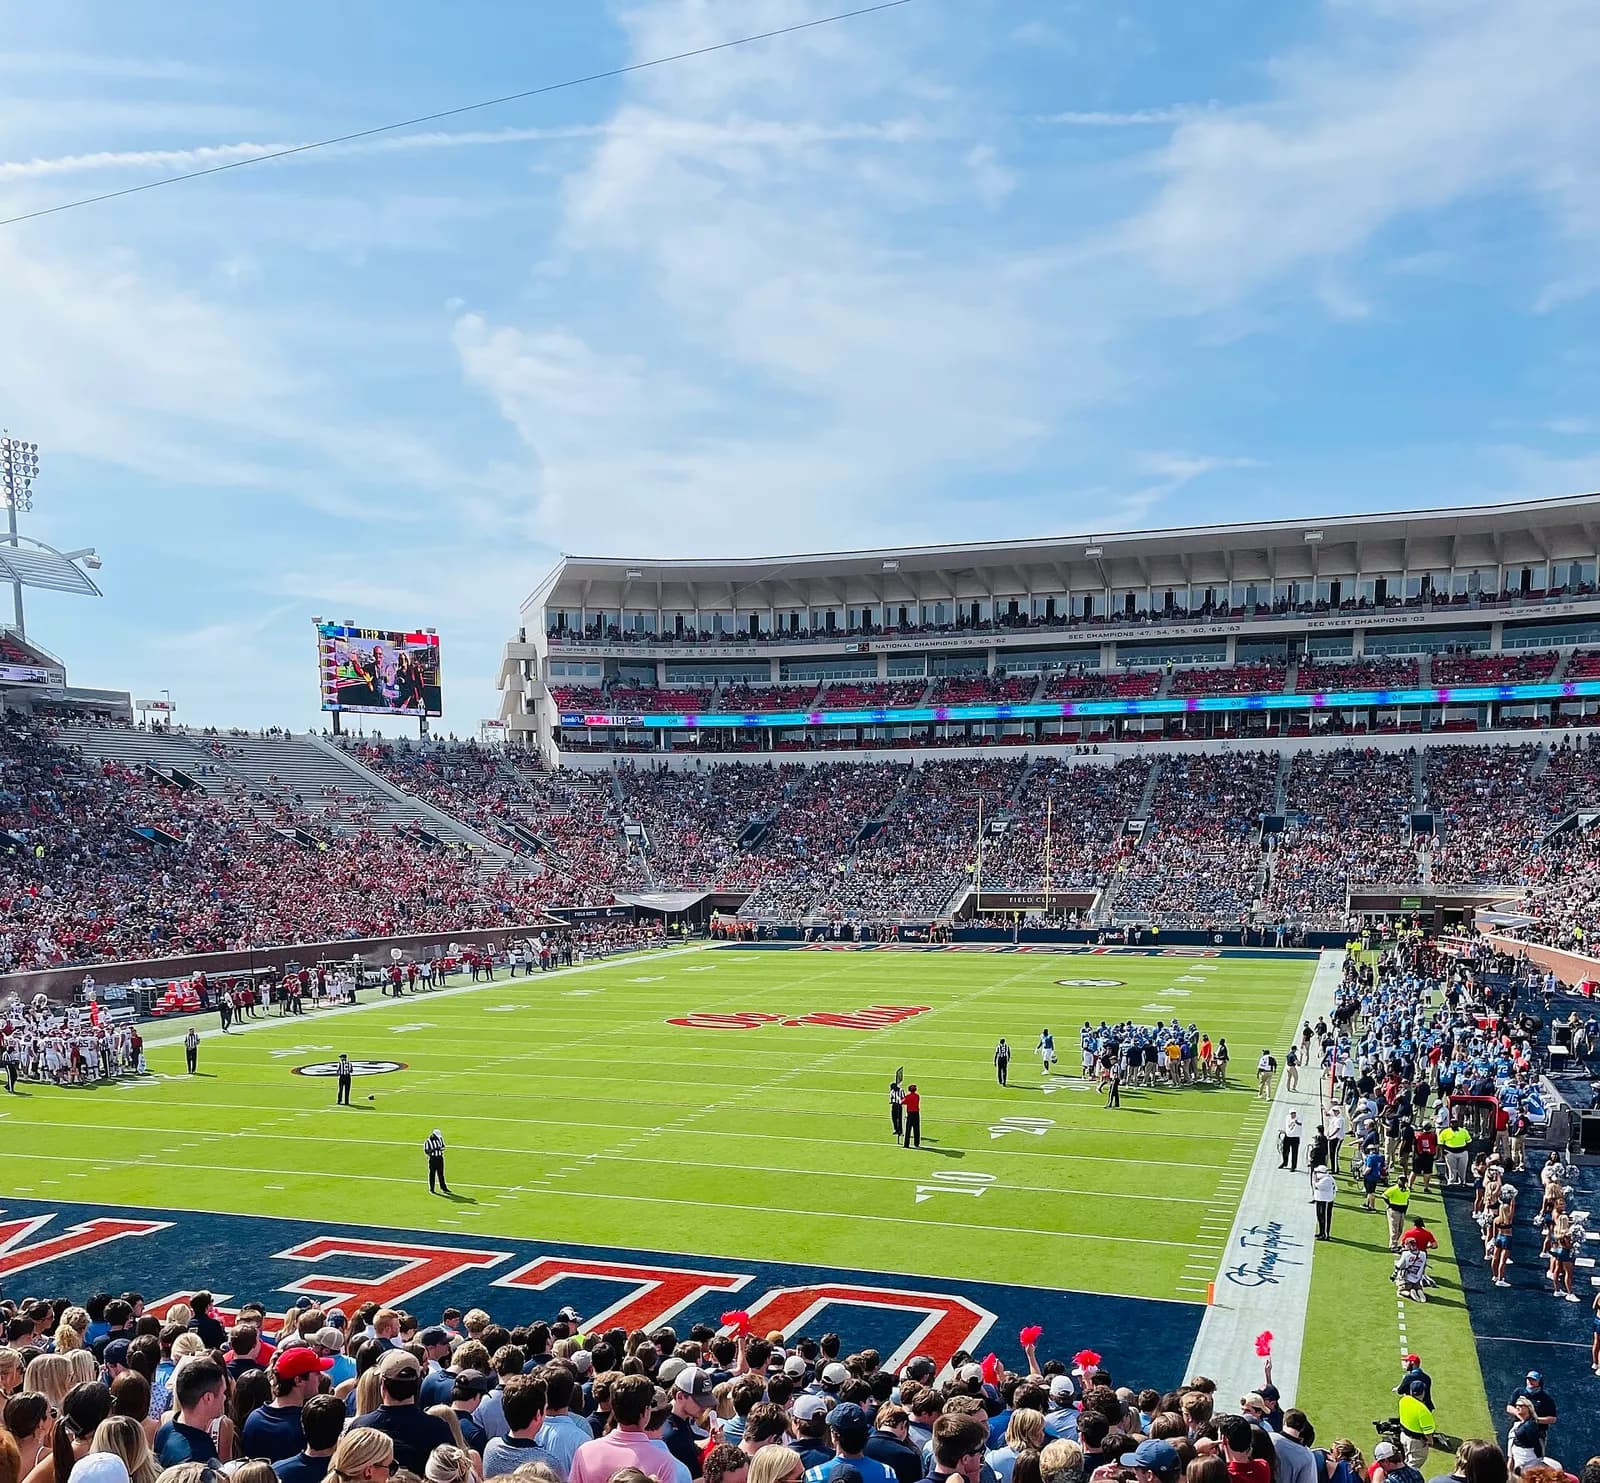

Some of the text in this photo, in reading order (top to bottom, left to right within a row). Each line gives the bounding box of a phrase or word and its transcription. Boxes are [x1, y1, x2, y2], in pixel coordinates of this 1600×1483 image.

[1354, 617, 1408, 625] CHAMPIONS
[987, 1116, 1056, 1136] 20
[914, 1170, 997, 1199] 10
